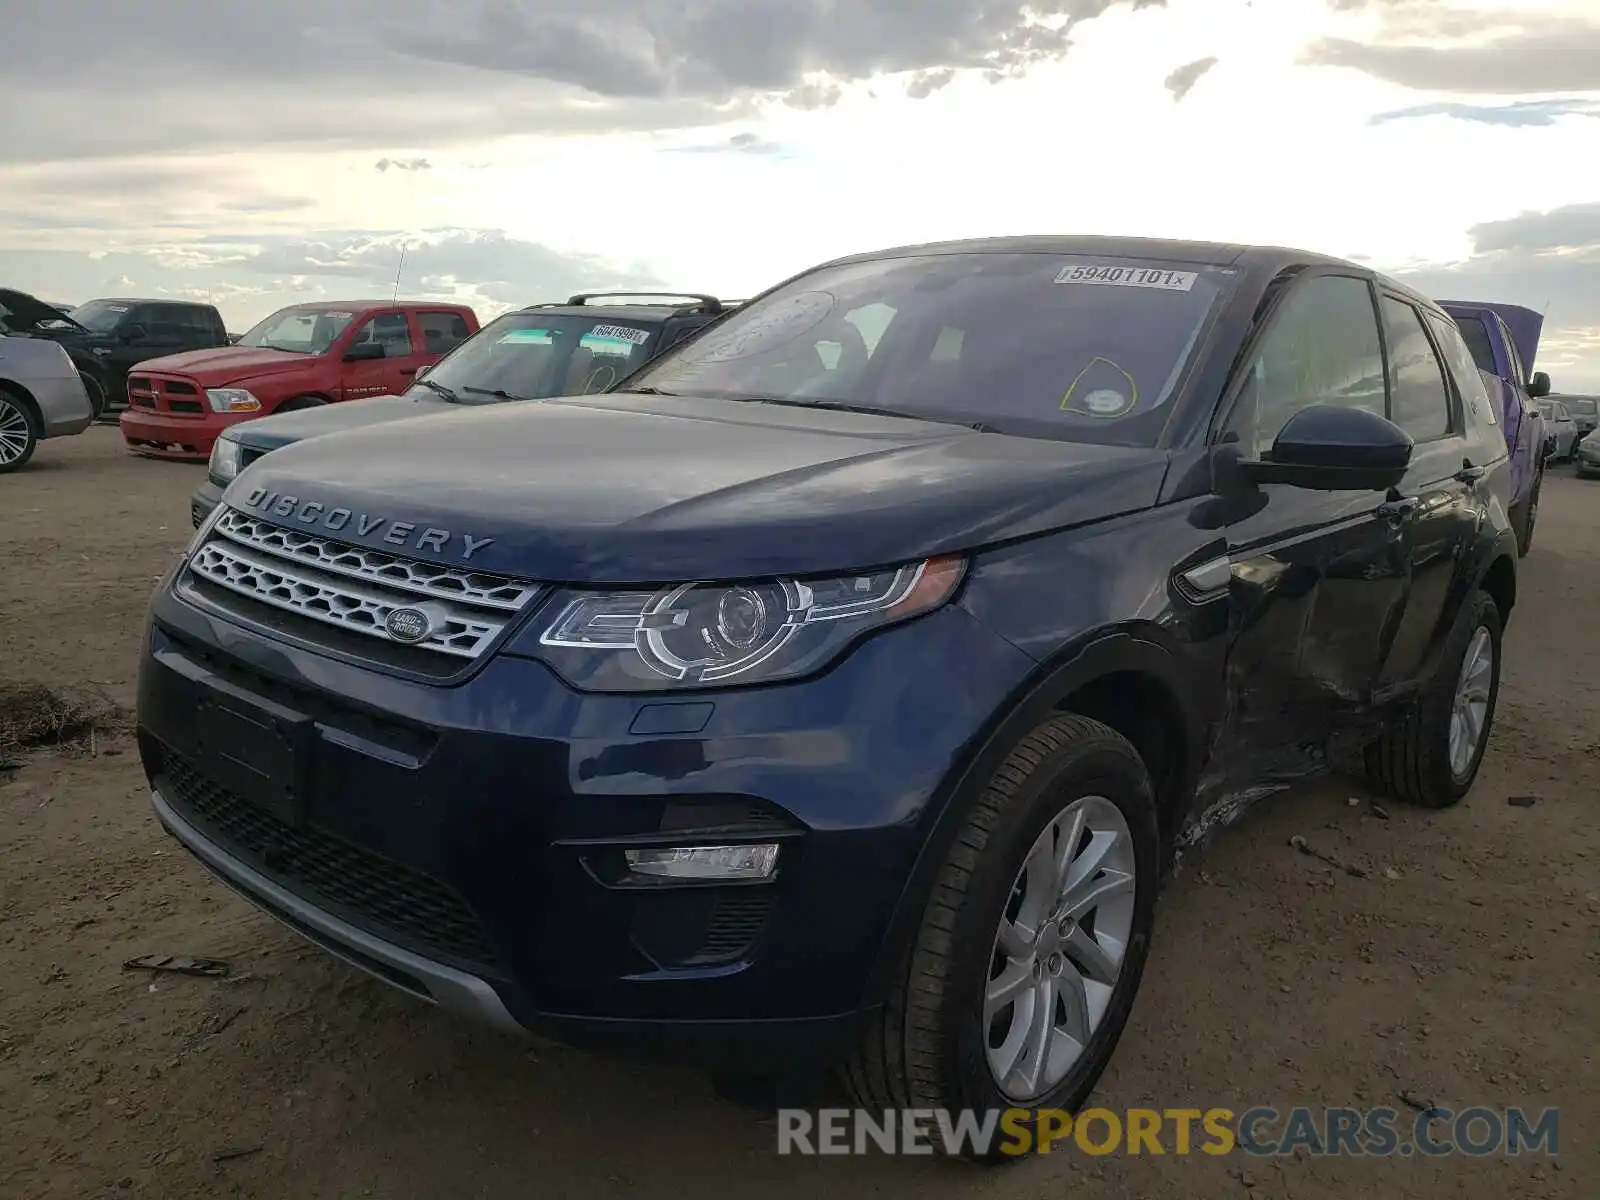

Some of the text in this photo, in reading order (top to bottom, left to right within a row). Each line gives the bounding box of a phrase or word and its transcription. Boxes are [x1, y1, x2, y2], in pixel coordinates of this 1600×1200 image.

[245, 487, 496, 560] DISCOVERY
[395, 612, 416, 624] LAND
[393, 622, 421, 635] ROVER
